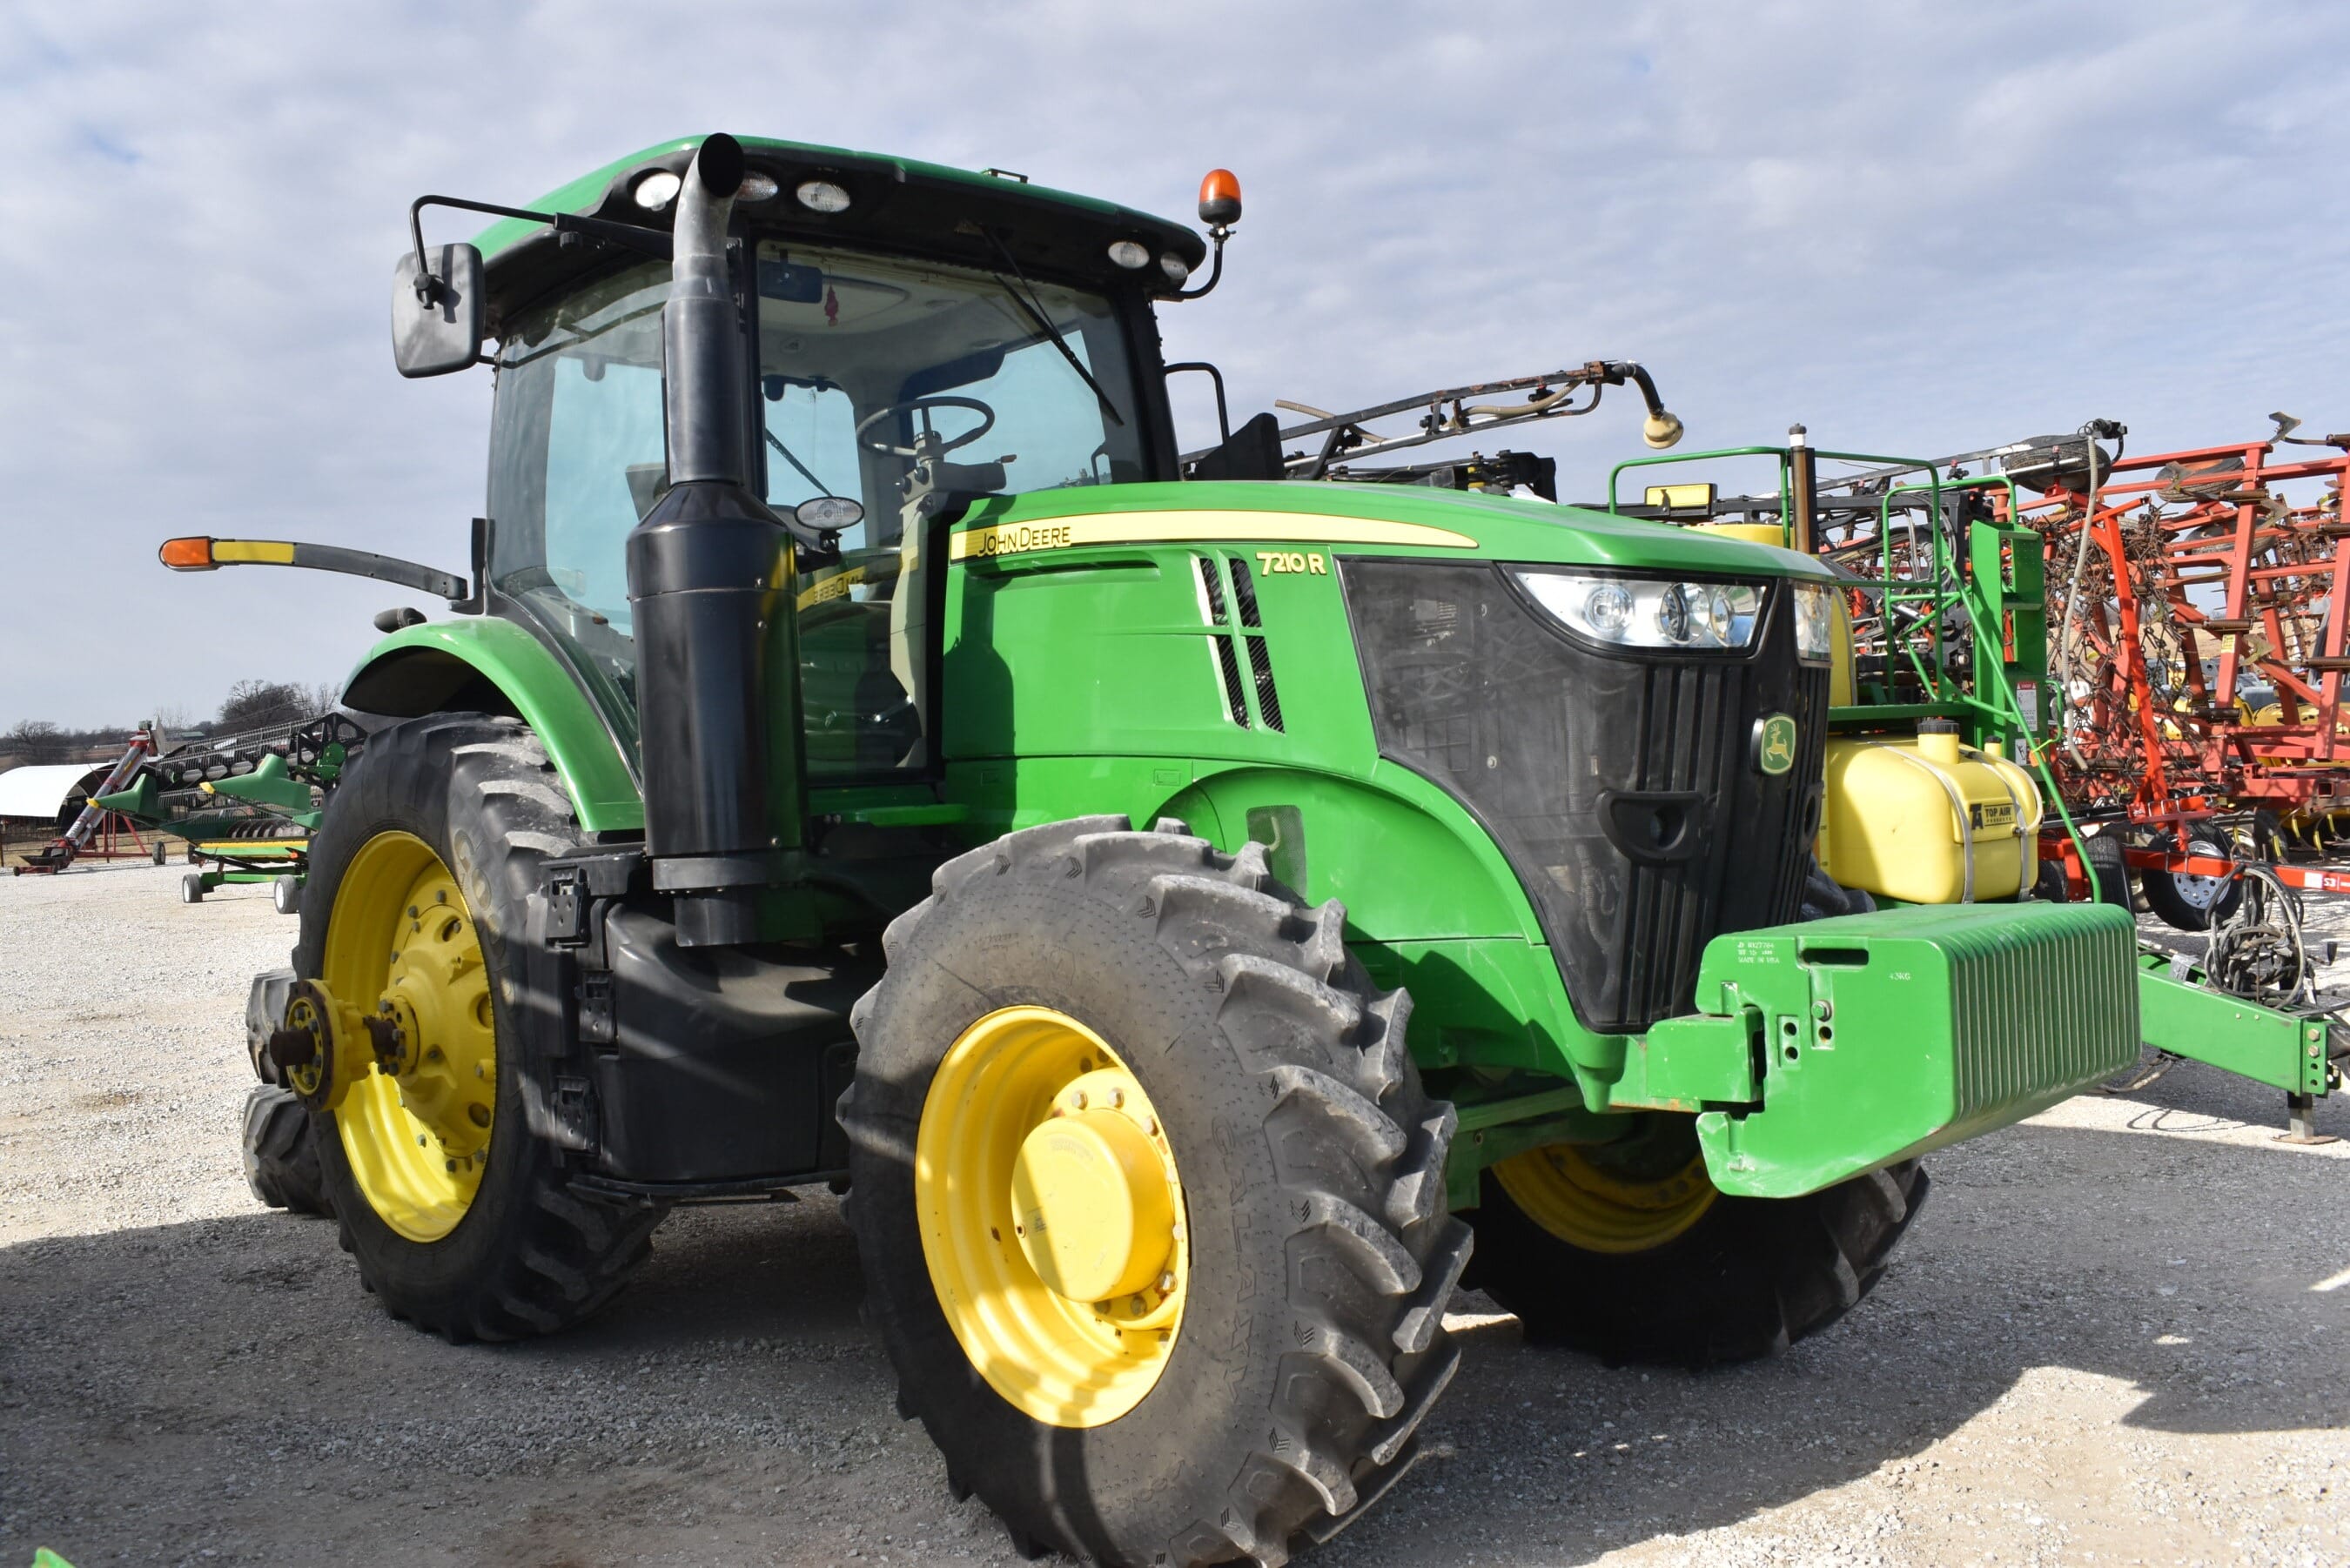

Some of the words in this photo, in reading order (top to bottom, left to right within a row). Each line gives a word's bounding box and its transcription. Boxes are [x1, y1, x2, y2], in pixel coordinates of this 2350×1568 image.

[978, 532, 1017, 554] JOHN
[1019, 526, 1071, 548] DEERE
[1255, 552, 1306, 577] 7210
[1307, 553, 1327, 575] R
[1985, 807, 1998, 818] TOP
[1999, 807, 2011, 816] AIR
